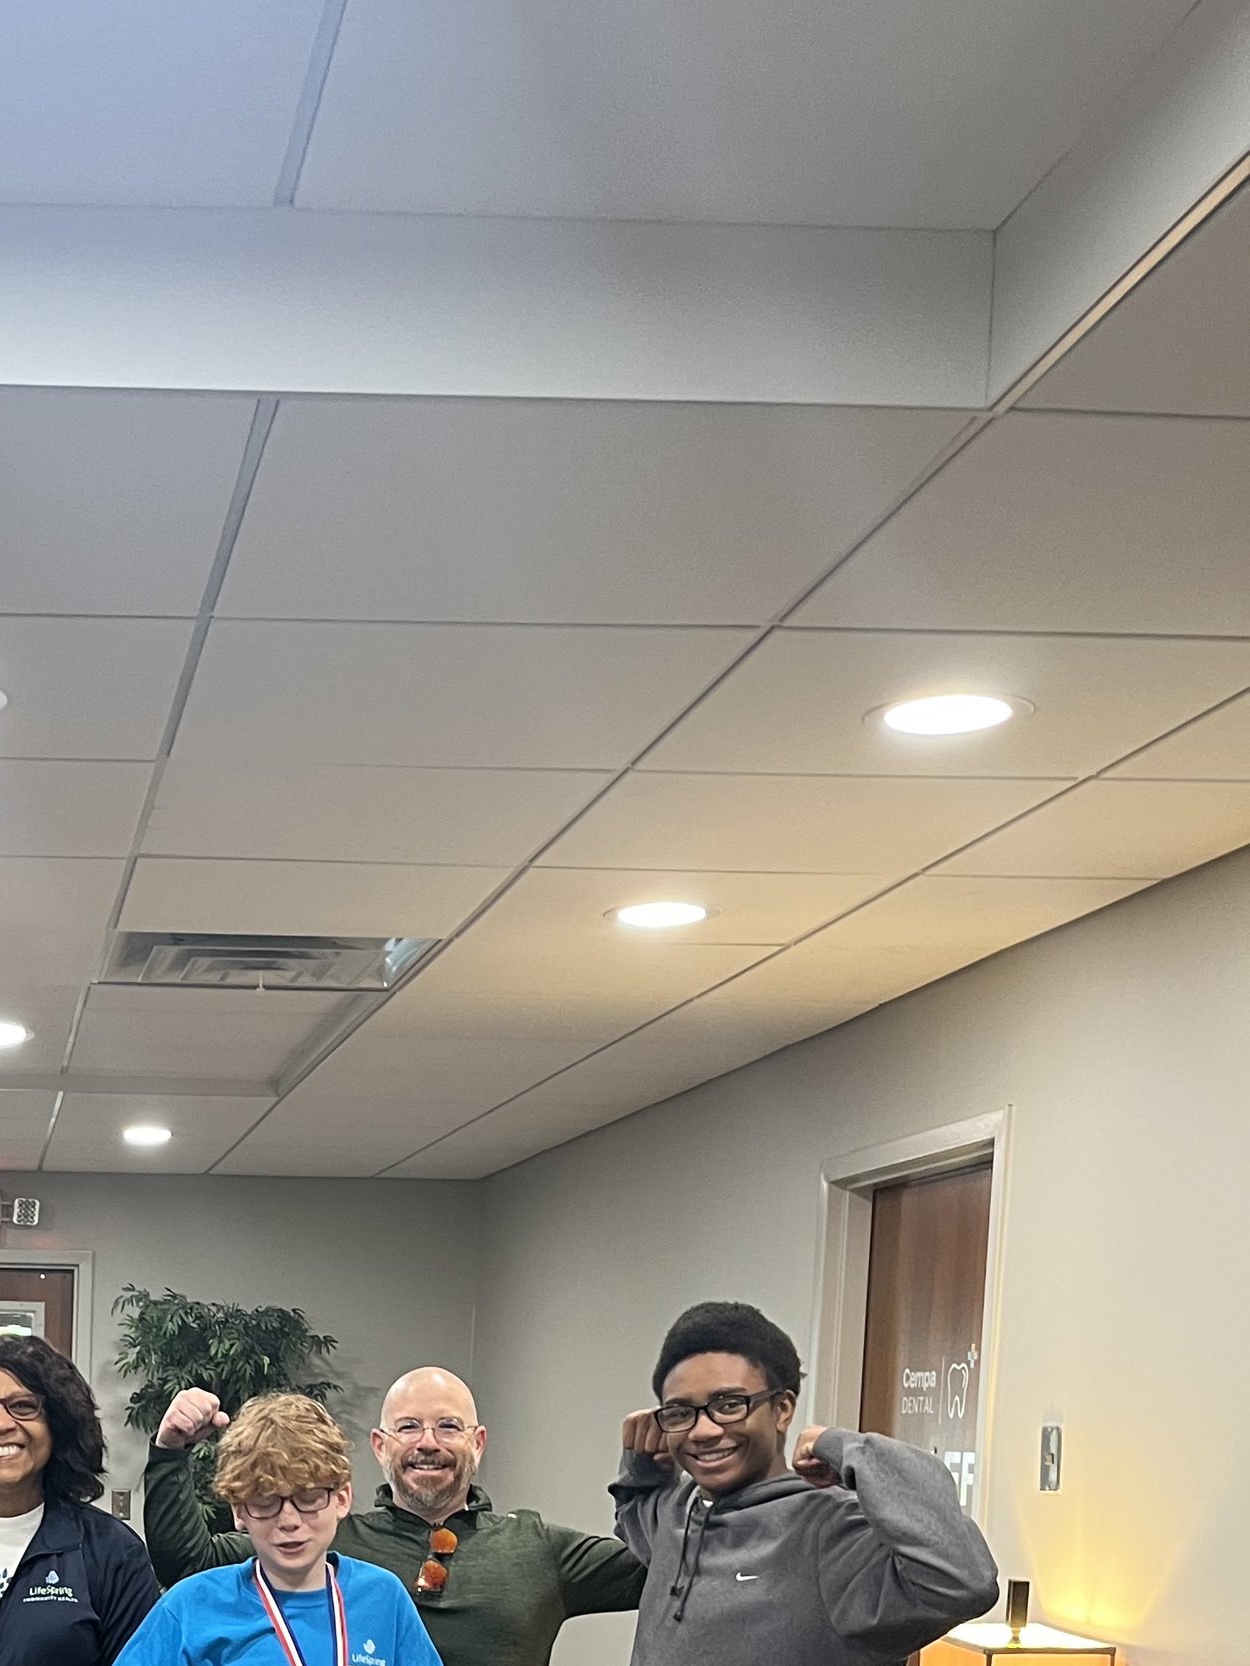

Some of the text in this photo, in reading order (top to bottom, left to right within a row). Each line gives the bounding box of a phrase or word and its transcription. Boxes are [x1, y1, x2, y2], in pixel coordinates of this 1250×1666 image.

[903, 1368, 937, 1391] Cempa
[902, 1397, 934, 1414] DENTAL
[30, 1585, 73, 1598] LifeSpring
